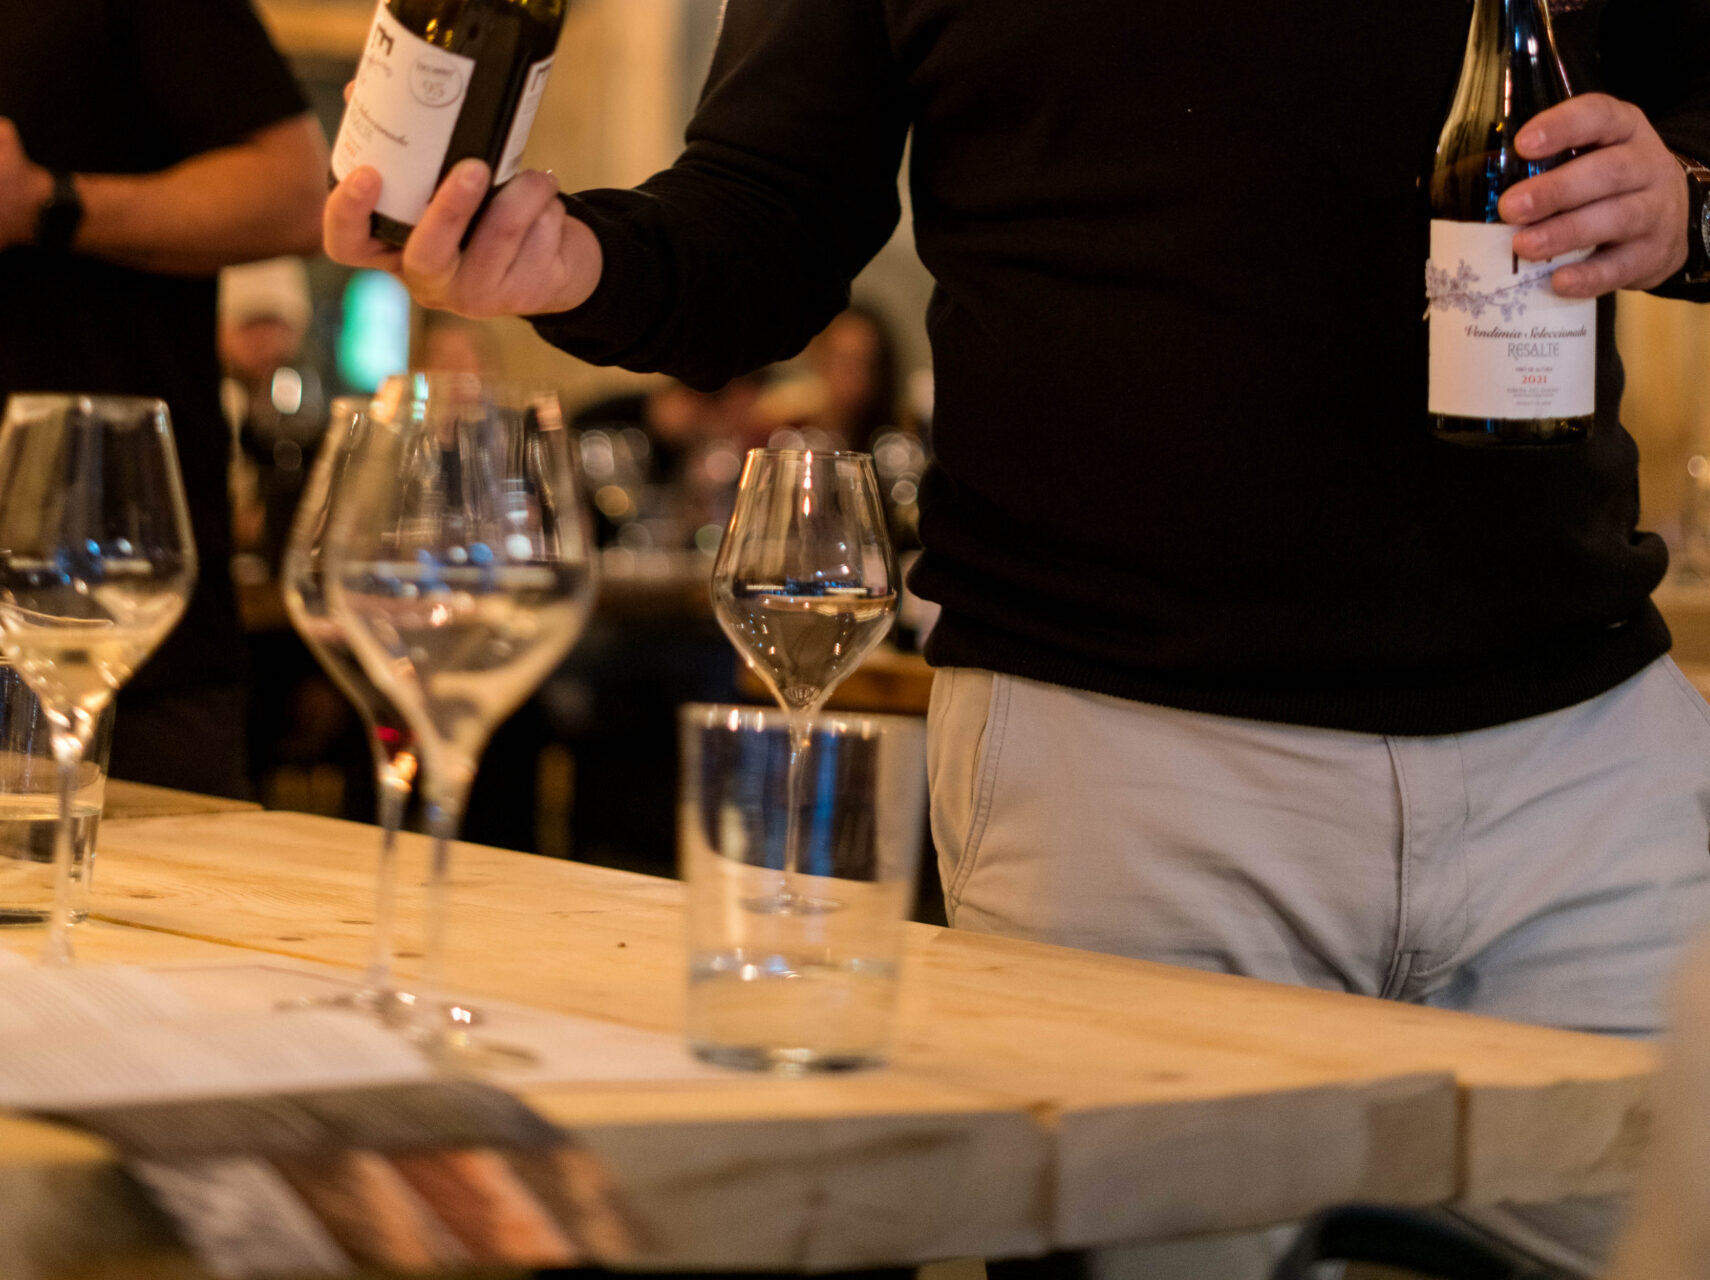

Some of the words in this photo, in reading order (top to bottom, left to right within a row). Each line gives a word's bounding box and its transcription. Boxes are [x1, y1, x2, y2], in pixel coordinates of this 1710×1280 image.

[1464, 325, 1521, 339] Vendimia
[1525, 325, 1587, 339] Seleccionada
[1507, 342, 1560, 360] RESALTE
[1522, 375, 1547, 385] 2021
